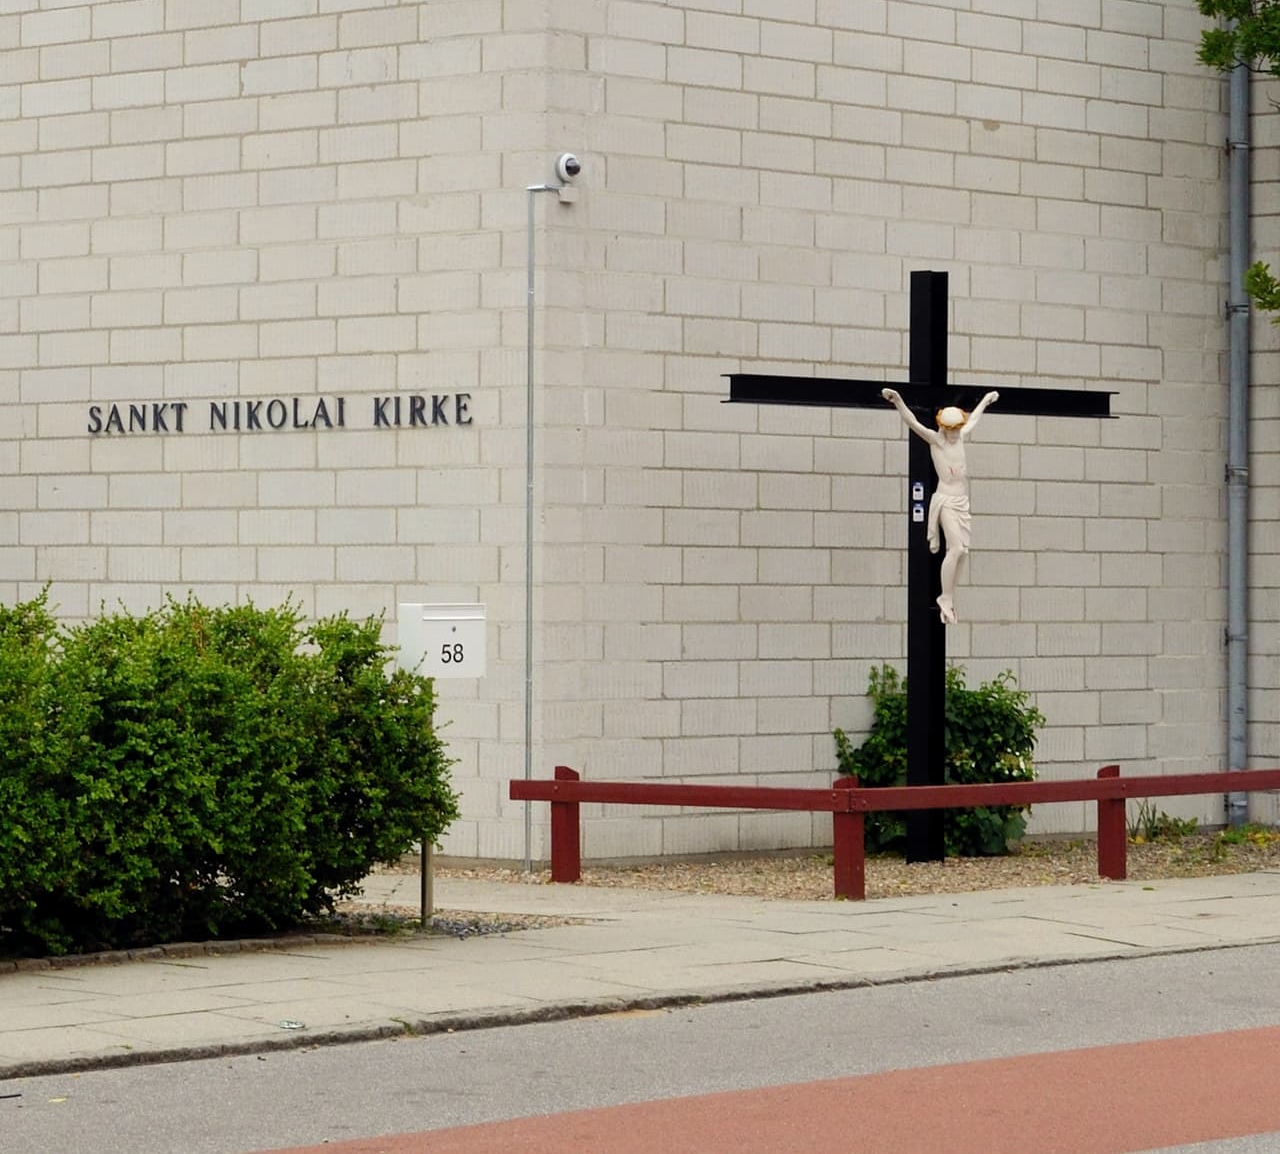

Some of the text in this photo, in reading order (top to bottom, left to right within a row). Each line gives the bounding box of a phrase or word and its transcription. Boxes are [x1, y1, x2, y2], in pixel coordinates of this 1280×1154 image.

[87, 393, 473, 434] SANKT NIKOLAI KIRKE
[441, 643, 464, 663] 58
